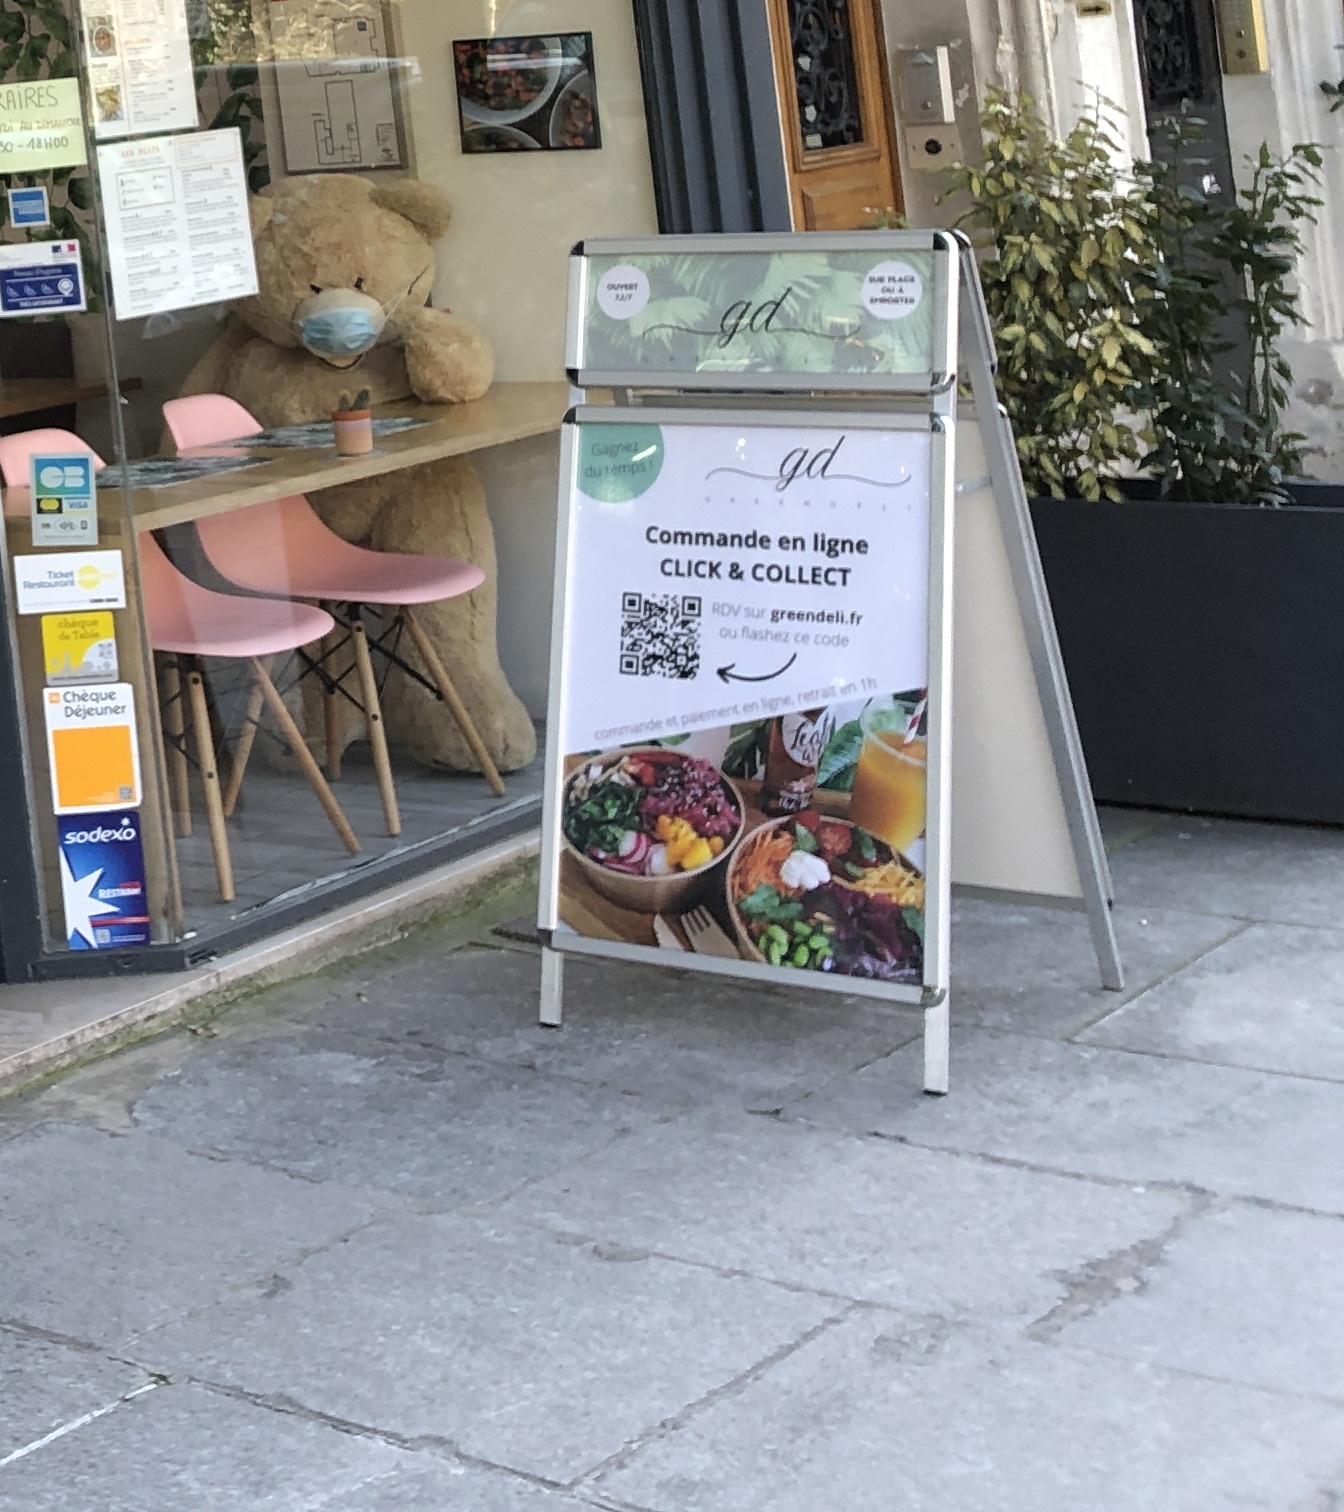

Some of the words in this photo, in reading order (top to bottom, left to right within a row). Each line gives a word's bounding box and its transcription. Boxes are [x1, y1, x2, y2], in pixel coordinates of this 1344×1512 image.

[20, 120, 33, 131] AU
[27, 136, 69, 149] 18H00
[590, 441, 640, 459] Gagnez
[584, 465, 602, 478] du
[645, 524, 772, 550] Commande
[777, 534, 806, 552] en
[812, 531, 870, 559] ligne
[46, 569, 75, 581] Ticket
[659, 557, 723, 580] CLICK
[728, 561, 745, 582] &
[751, 562, 852, 587] COLLECT
[23, 578, 75, 590] Restaurant
[712, 601, 743, 618] RDV
[743, 606, 767, 620] sur
[769, 608, 864, 627] greendeli.fr
[57, 616, 99, 630] chèque
[71, 629, 100, 640] Table
[719, 626, 738, 639] ou
[740, 625, 790, 645] flashez
[793, 632, 810, 646] ce
[813, 631, 850, 648] code
[62, 689, 117, 704] Chèque
[64, 703, 127, 720] Déjeuner
[593, 717, 662, 741] commande
[665, 714, 677, 730] et
[680, 703, 740, 731] paiement
[742, 702, 760, 715] en
[797, 686, 837, 705] retrait
[839, 683, 858, 698] en
[64, 825, 137, 845] sodexo
